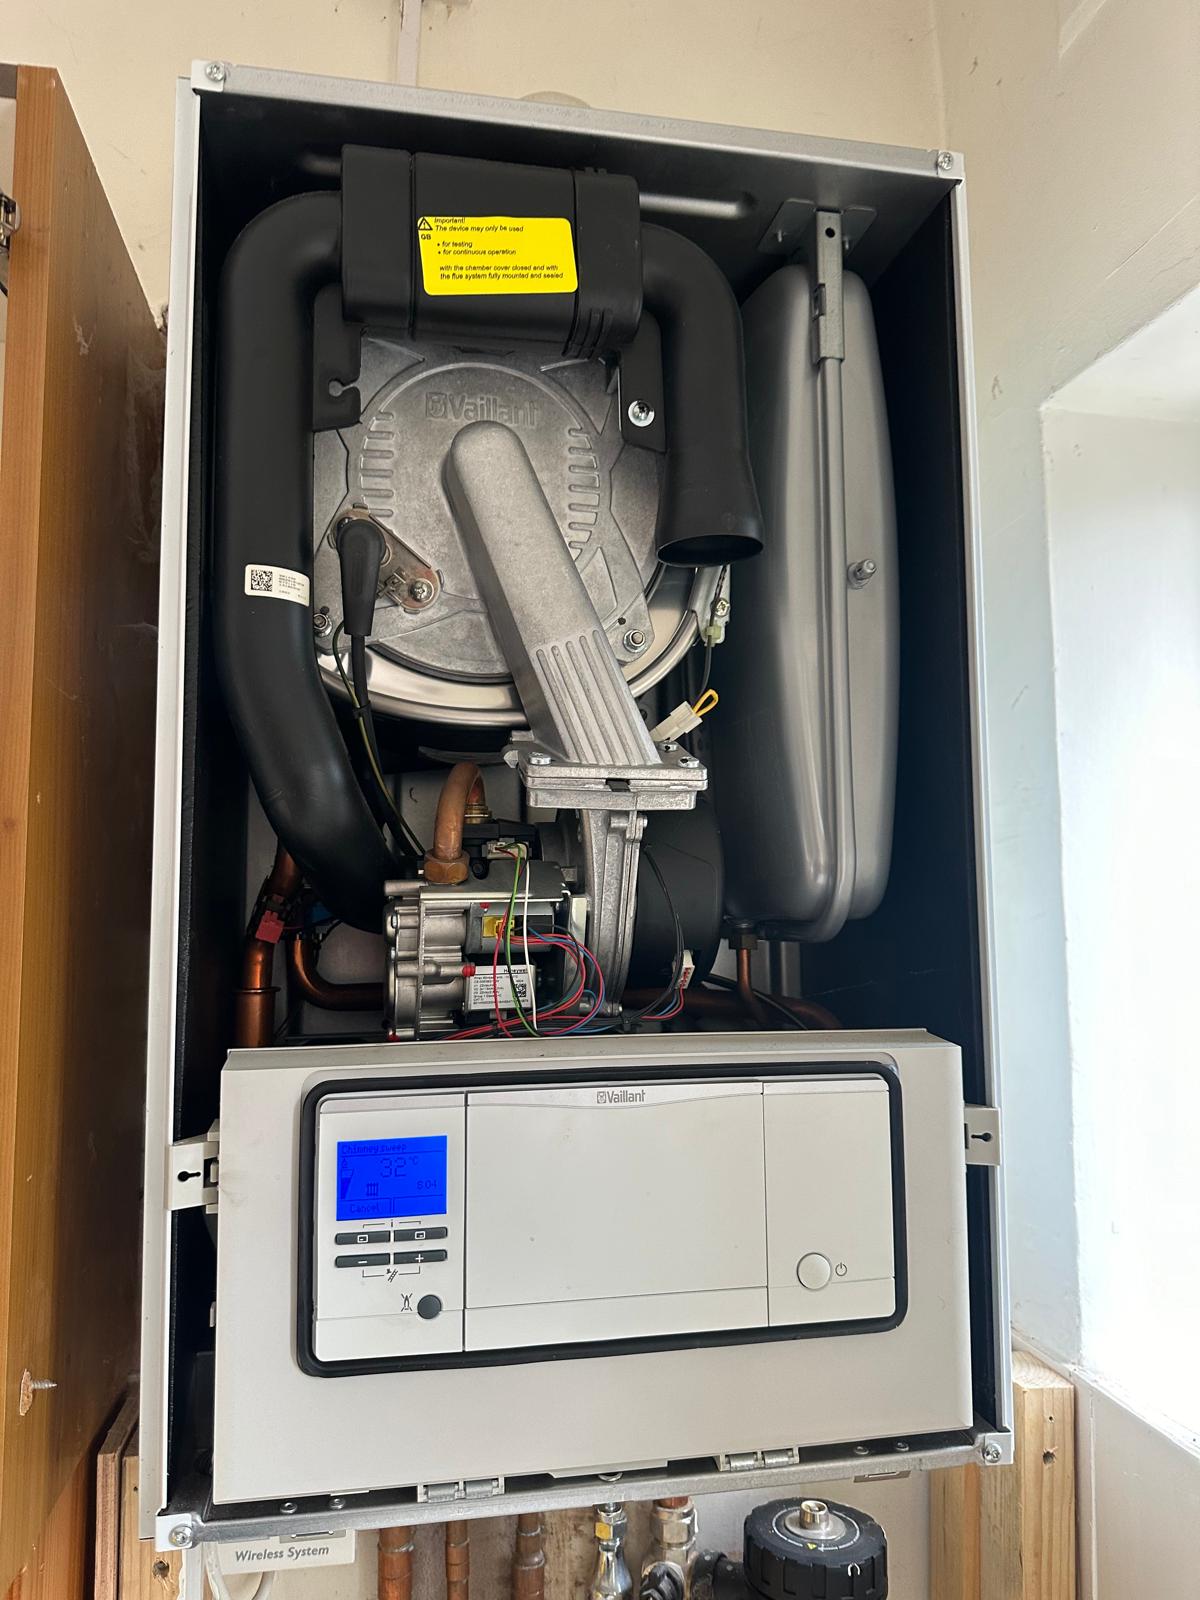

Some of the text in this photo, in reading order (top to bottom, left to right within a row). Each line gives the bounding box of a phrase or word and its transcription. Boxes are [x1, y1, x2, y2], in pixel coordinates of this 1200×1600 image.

[447, 393, 538, 427] Vaillant
[606, 1089, 646, 1103] Vaillant
[342, 1143, 407, 1155] Chimney sweep
[380, 1155, 419, 1178] 32 °C
[351, 1202, 379, 1213] Cancel
[235, 1546, 330, 1561] Wireless System
